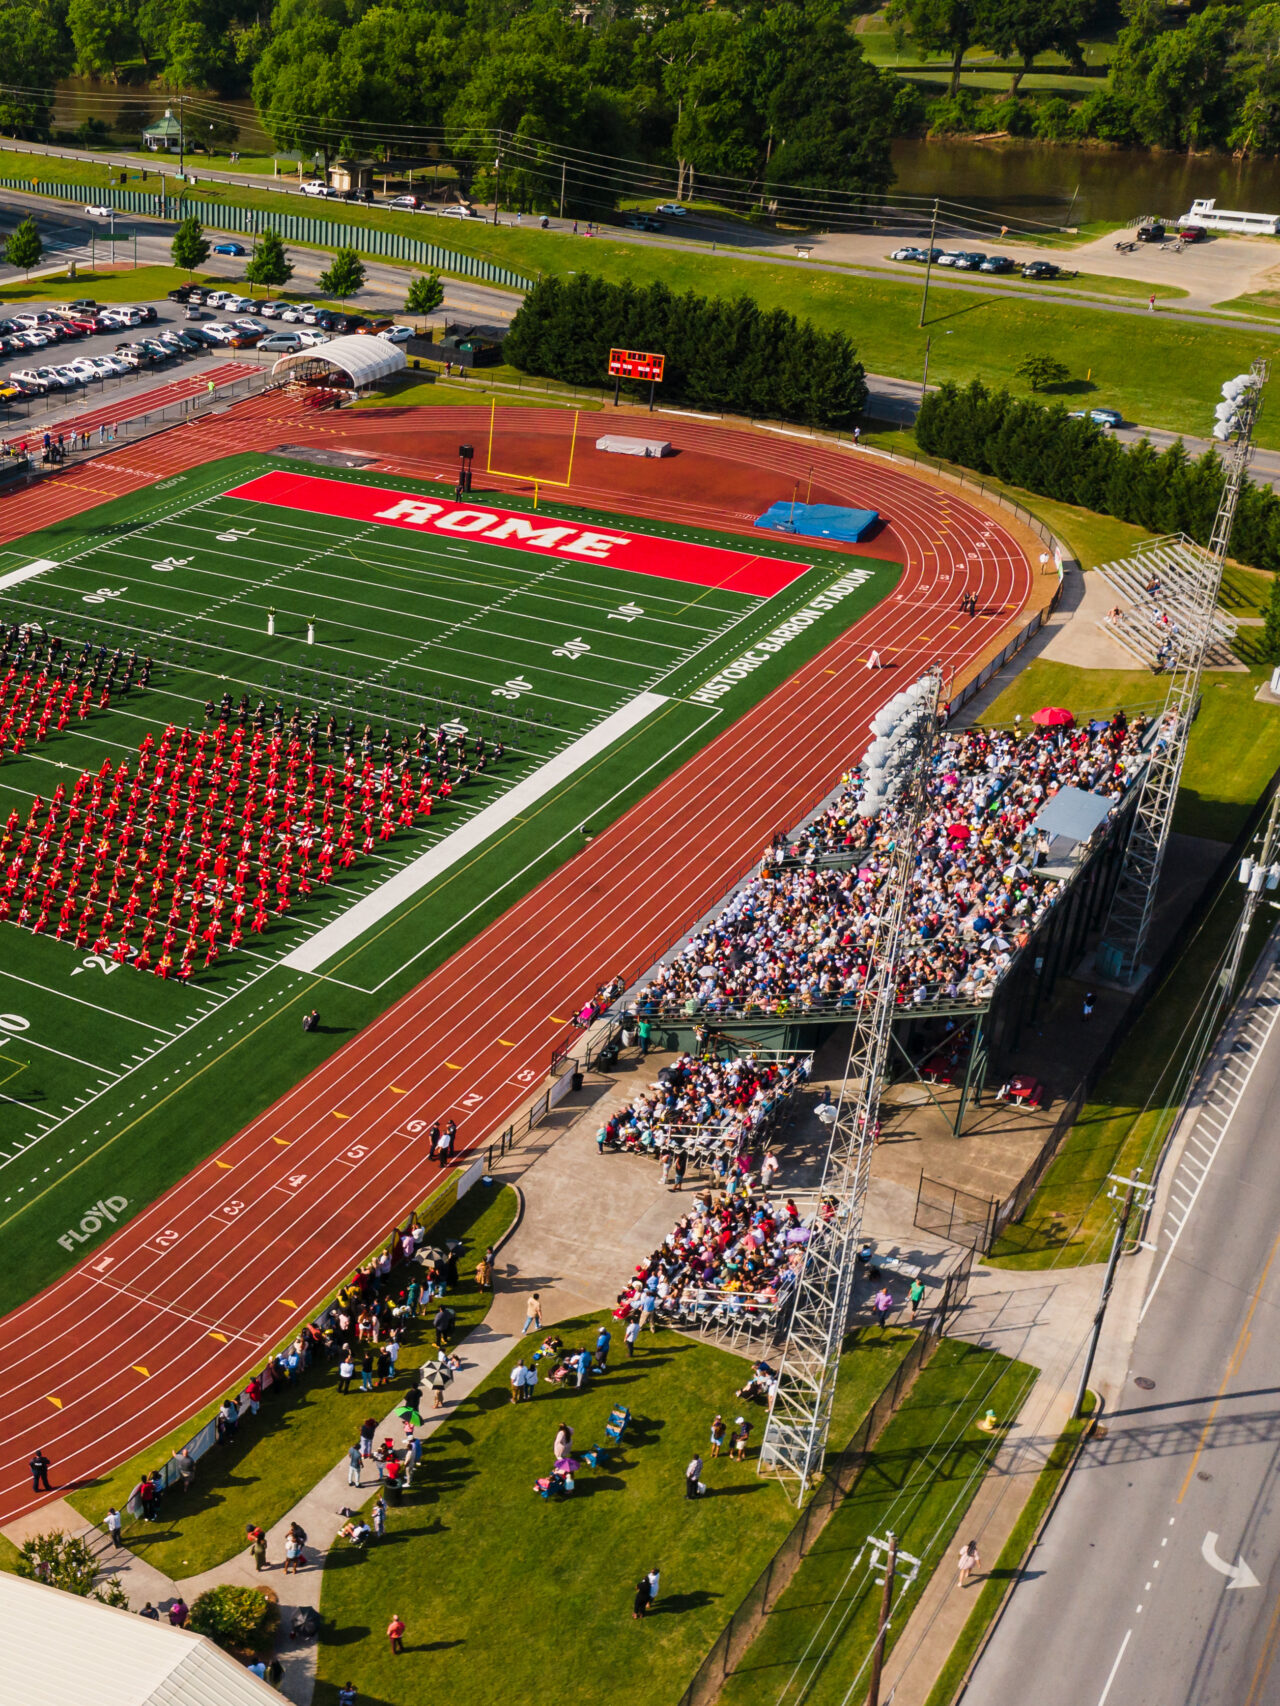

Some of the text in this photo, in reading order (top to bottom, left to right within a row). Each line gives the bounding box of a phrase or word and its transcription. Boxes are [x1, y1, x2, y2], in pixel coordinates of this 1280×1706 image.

[215, 528, 252, 542] 10
[373, 499, 632, 558] ROME
[151, 556, 188, 572] 20
[82, 588, 121, 603] 30
[607, 603, 645, 623] 10
[690, 568, 875, 704] HISTORIC BARRON STADIUM
[552, 641, 591, 660] 20
[491, 680, 533, 700] 30
[517, 1069, 535, 1082] 8
[406, 1120, 427, 1133] 6
[347, 1144, 369, 1158] 5
[288, 1174, 308, 1187] 4
[223, 1200, 245, 1215] 3
[56, 1195, 129, 1253] FLOYD
[155, 1230, 179, 1246] 2
[91, 1256, 115, 1273] 1
